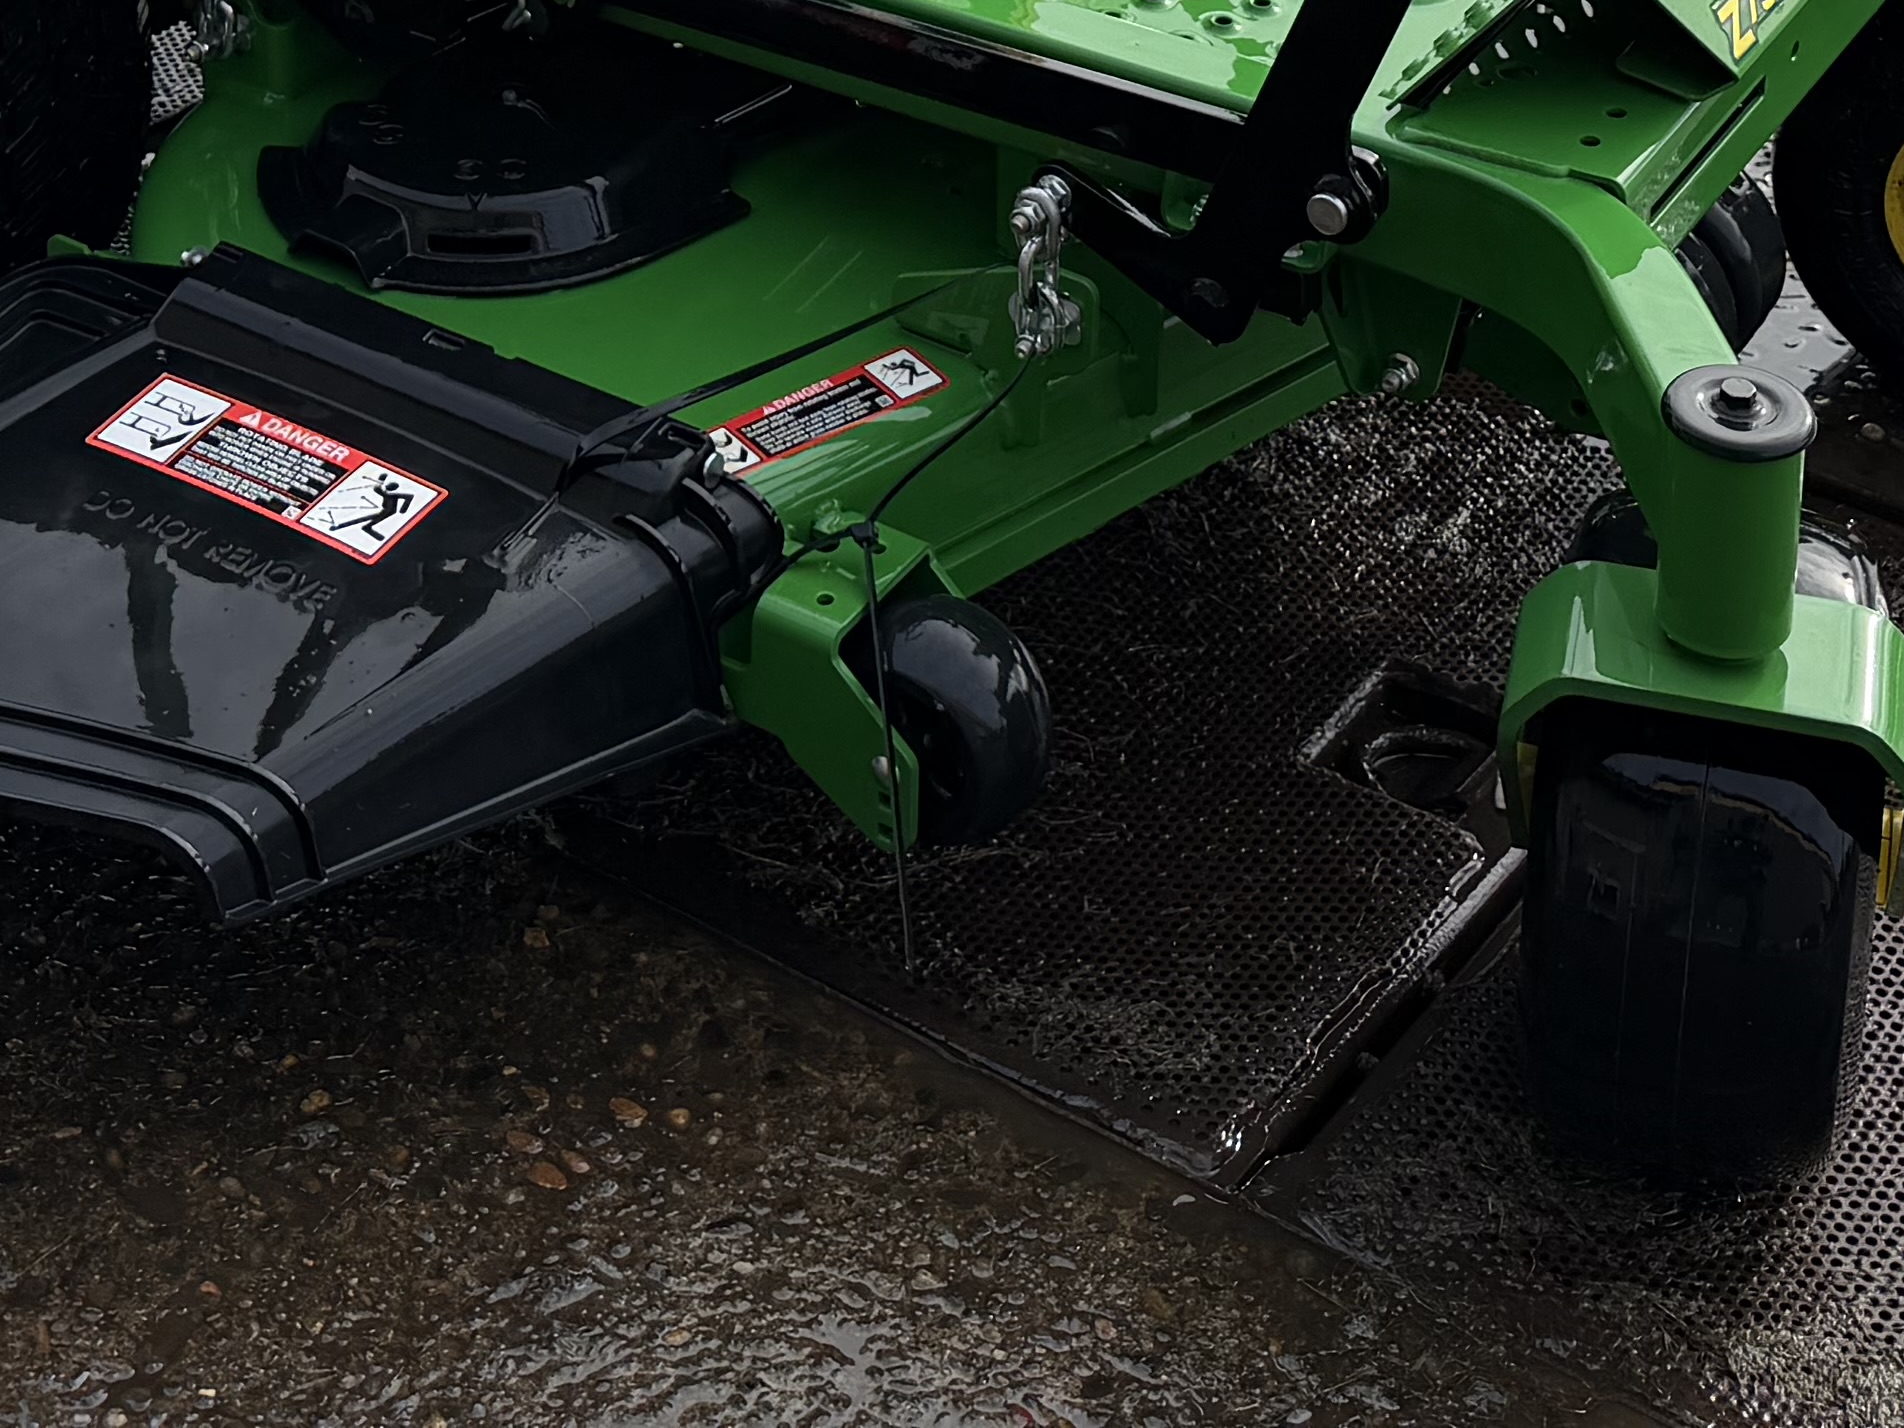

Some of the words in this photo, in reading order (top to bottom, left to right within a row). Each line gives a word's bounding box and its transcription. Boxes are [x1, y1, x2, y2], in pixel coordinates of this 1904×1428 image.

[772, 379, 835, 410] DANGER
[262, 417, 350, 463] DANGER
[137, 513, 212, 550] NOT
[203, 539, 338, 611] REMOVE
